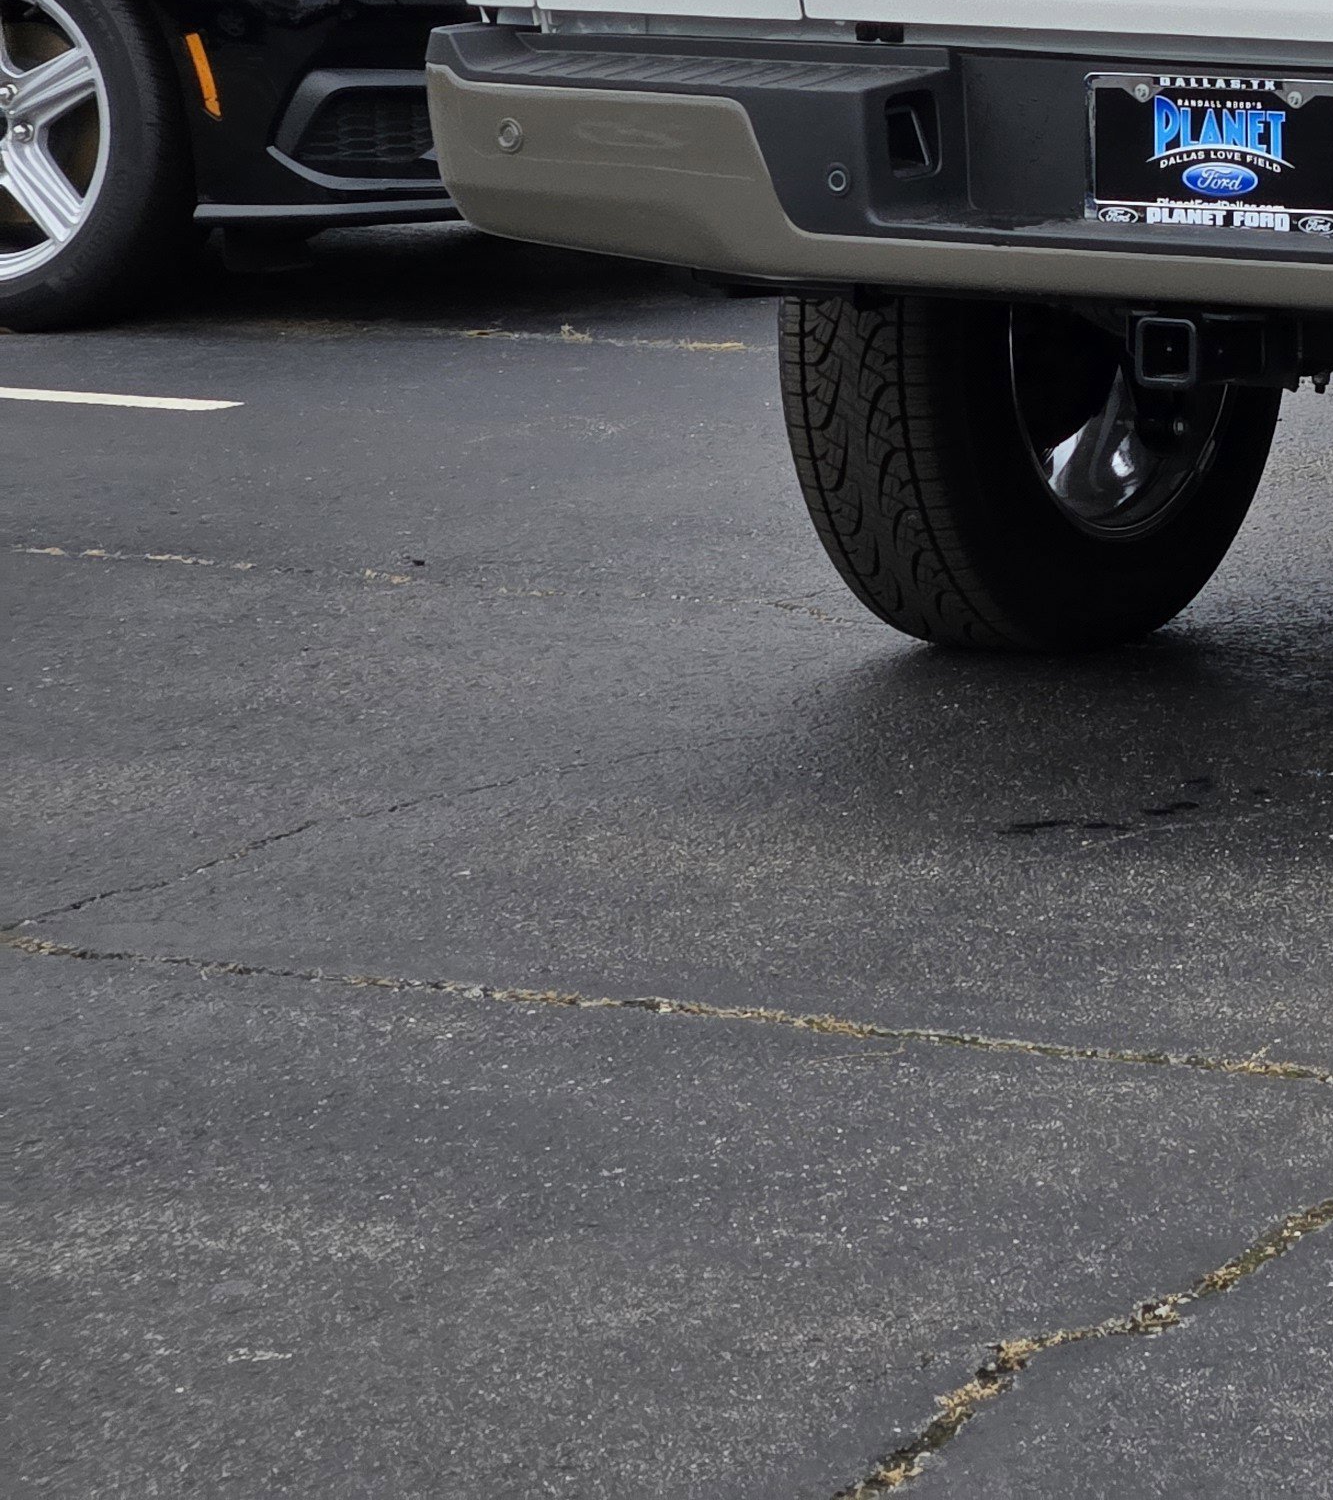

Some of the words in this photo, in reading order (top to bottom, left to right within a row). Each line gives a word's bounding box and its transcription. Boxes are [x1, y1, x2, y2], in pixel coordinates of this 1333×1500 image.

[1250, 79, 1276, 91] TX
[1154, 95, 1286, 160] PLANET
[1160, 150, 1206, 169] DALLAS
[1210, 150, 1242, 162] LOVE
[1246, 155, 1281, 173] FIELD
[1197, 167, 1243, 191] Ford
[1105, 209, 1132, 222] Ford
[1146, 206, 1227, 226] PLANET
[1233, 211, 1290, 232] FORD
[1305, 218, 1332, 232] Ford
